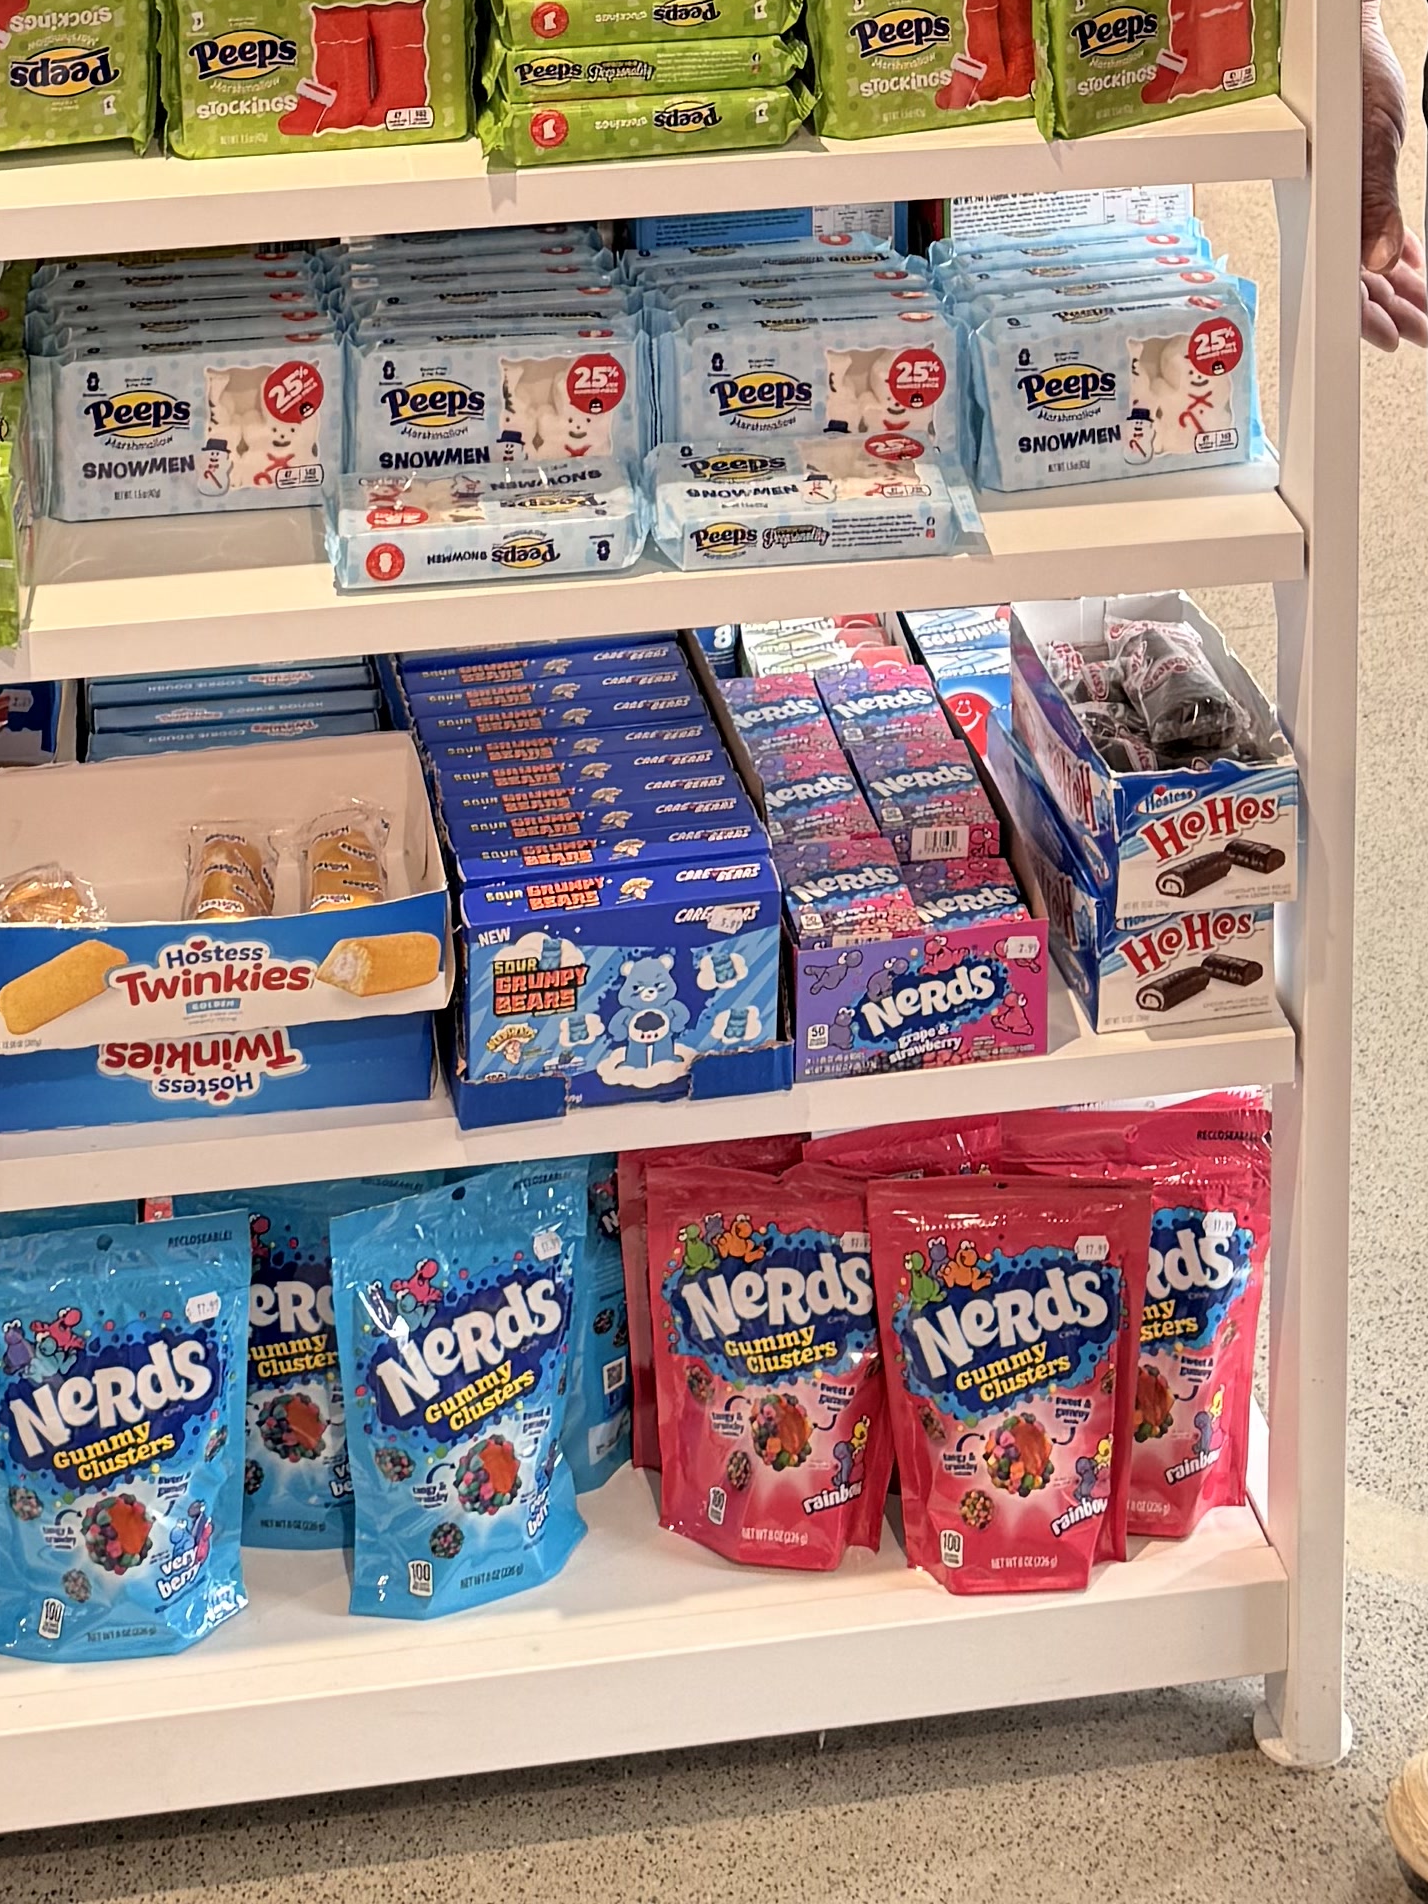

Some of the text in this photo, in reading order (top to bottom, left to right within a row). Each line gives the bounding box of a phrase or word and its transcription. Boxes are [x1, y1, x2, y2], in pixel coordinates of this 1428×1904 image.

[851, 12, 951, 54] Peeps
[1072, 12, 1158, 54] Peeps
[10, 47, 119, 89] Peeps
[189, 33, 299, 77] Peeps
[380, 386, 486, 425] Peeps
[710, 376, 814, 412] Peeps
[1017, 368, 1117, 407] Peeps
[84, 397, 191, 436] Peeps
[378, 445, 491, 471] SNOWMEN
[1018, 424, 1122, 454] SNOWMEN
[82, 454, 196, 482] SNOWMEN
[691, 526, 758, 550] Peeps
[1140, 796, 1276, 863] HoHos
[486, 876, 606, 902] SOUR GRUMPY
[675, 864, 761, 882] CARE BEARS
[529, 890, 601, 911] BEARS
[166, 945, 264, 969] Hostess
[1122, 911, 1253, 978] HoHos
[116, 965, 313, 1007] Twinkies
[493, 966, 588, 995] GRUMPY
[493, 988, 578, 1016] BEARS
[104, 1029, 298, 1074] Twinkies
[888, 1036, 963, 1066] strawberry
[898, 1025, 949, 1049] grape &
[158, 1071, 254, 1094] Hostess
[724, 1327, 816, 1361] Gummy
[744, 1340, 838, 1376] Clusters
[954, 1343, 1047, 1394] Gummy
[978, 1353, 1072, 1403] Clusters
[423, 1361, 514, 1425] Gummy
[448, 1369, 536, 1432] Clusters
[51, 1421, 152, 1470] Gummy
[76, 1432, 176, 1483] Clusters
